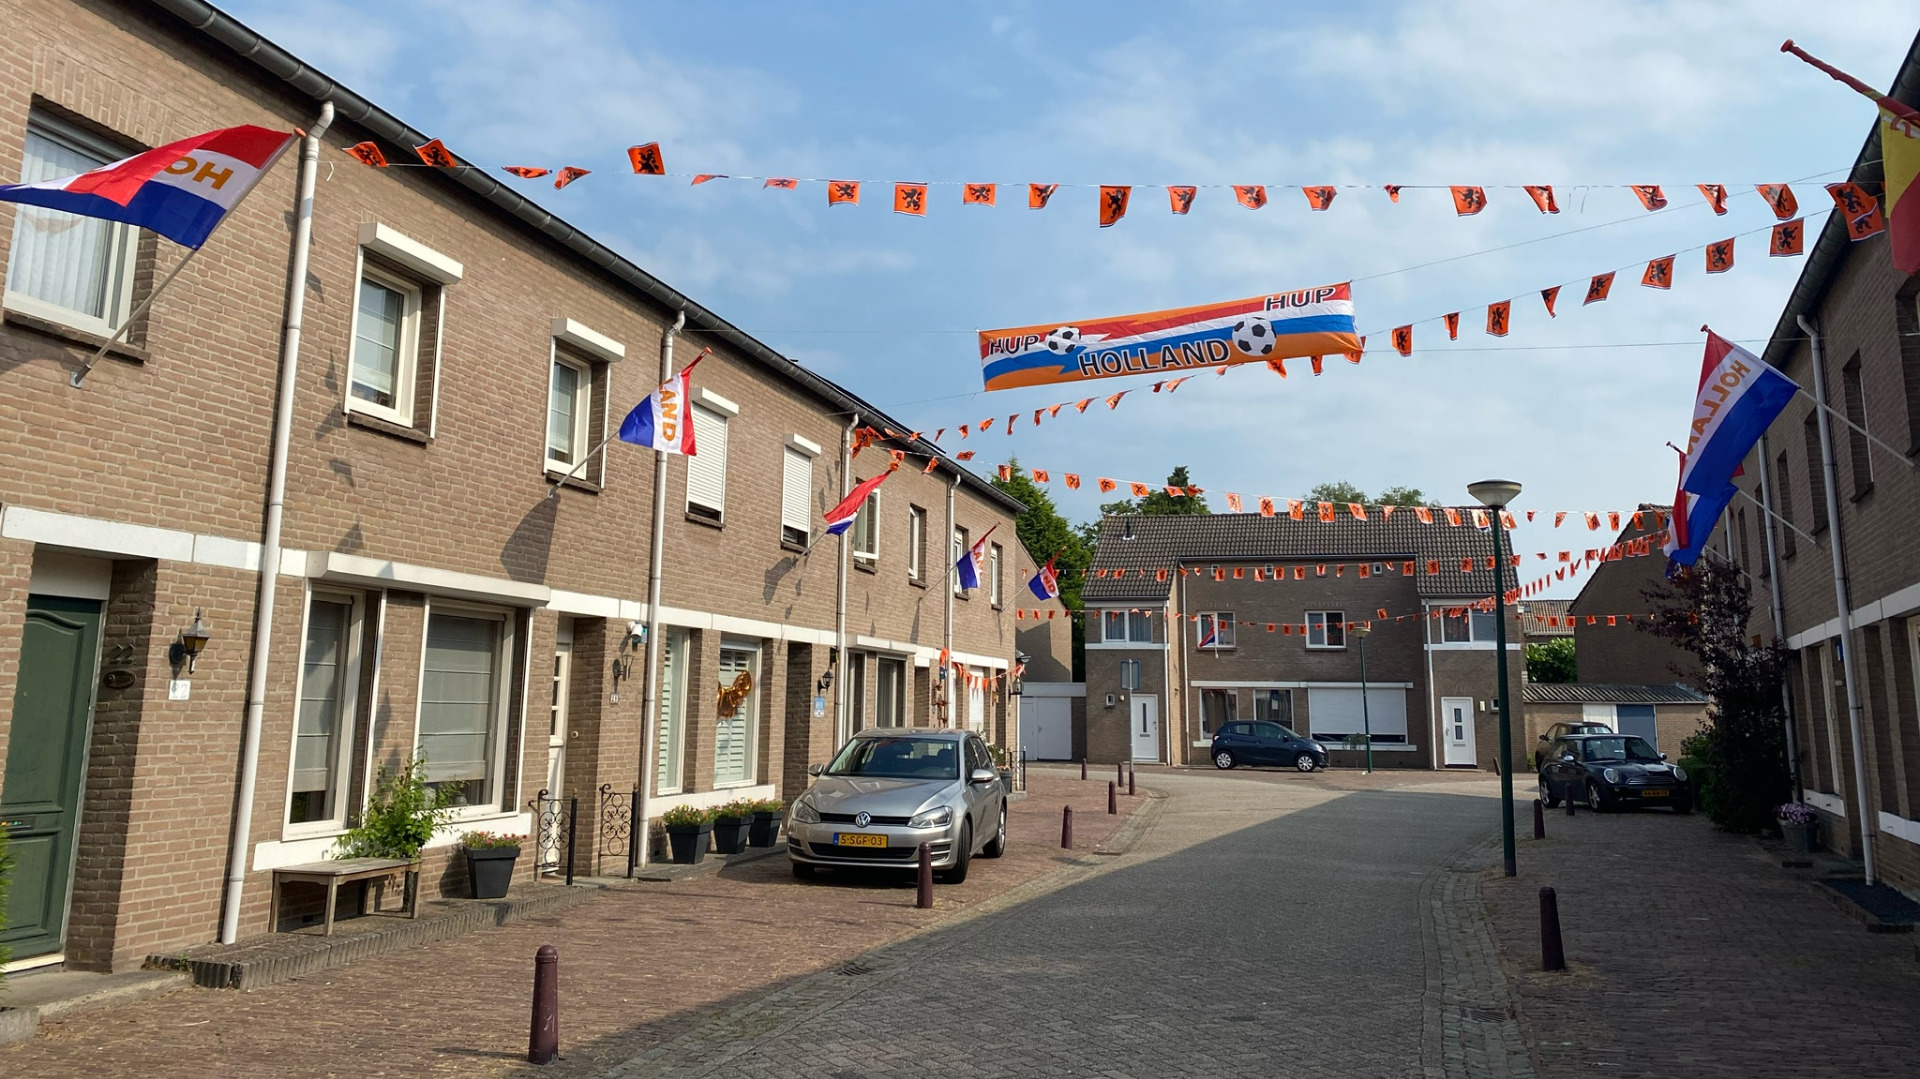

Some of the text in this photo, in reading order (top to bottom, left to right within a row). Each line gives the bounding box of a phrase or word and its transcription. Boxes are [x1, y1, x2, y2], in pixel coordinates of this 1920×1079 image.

[1264, 286, 1336, 312] HUP
[989, 333, 1041, 356] HUP
[1077, 338, 1231, 377] HOLLAND
[841, 834, 883, 846] 5-SGF-03
